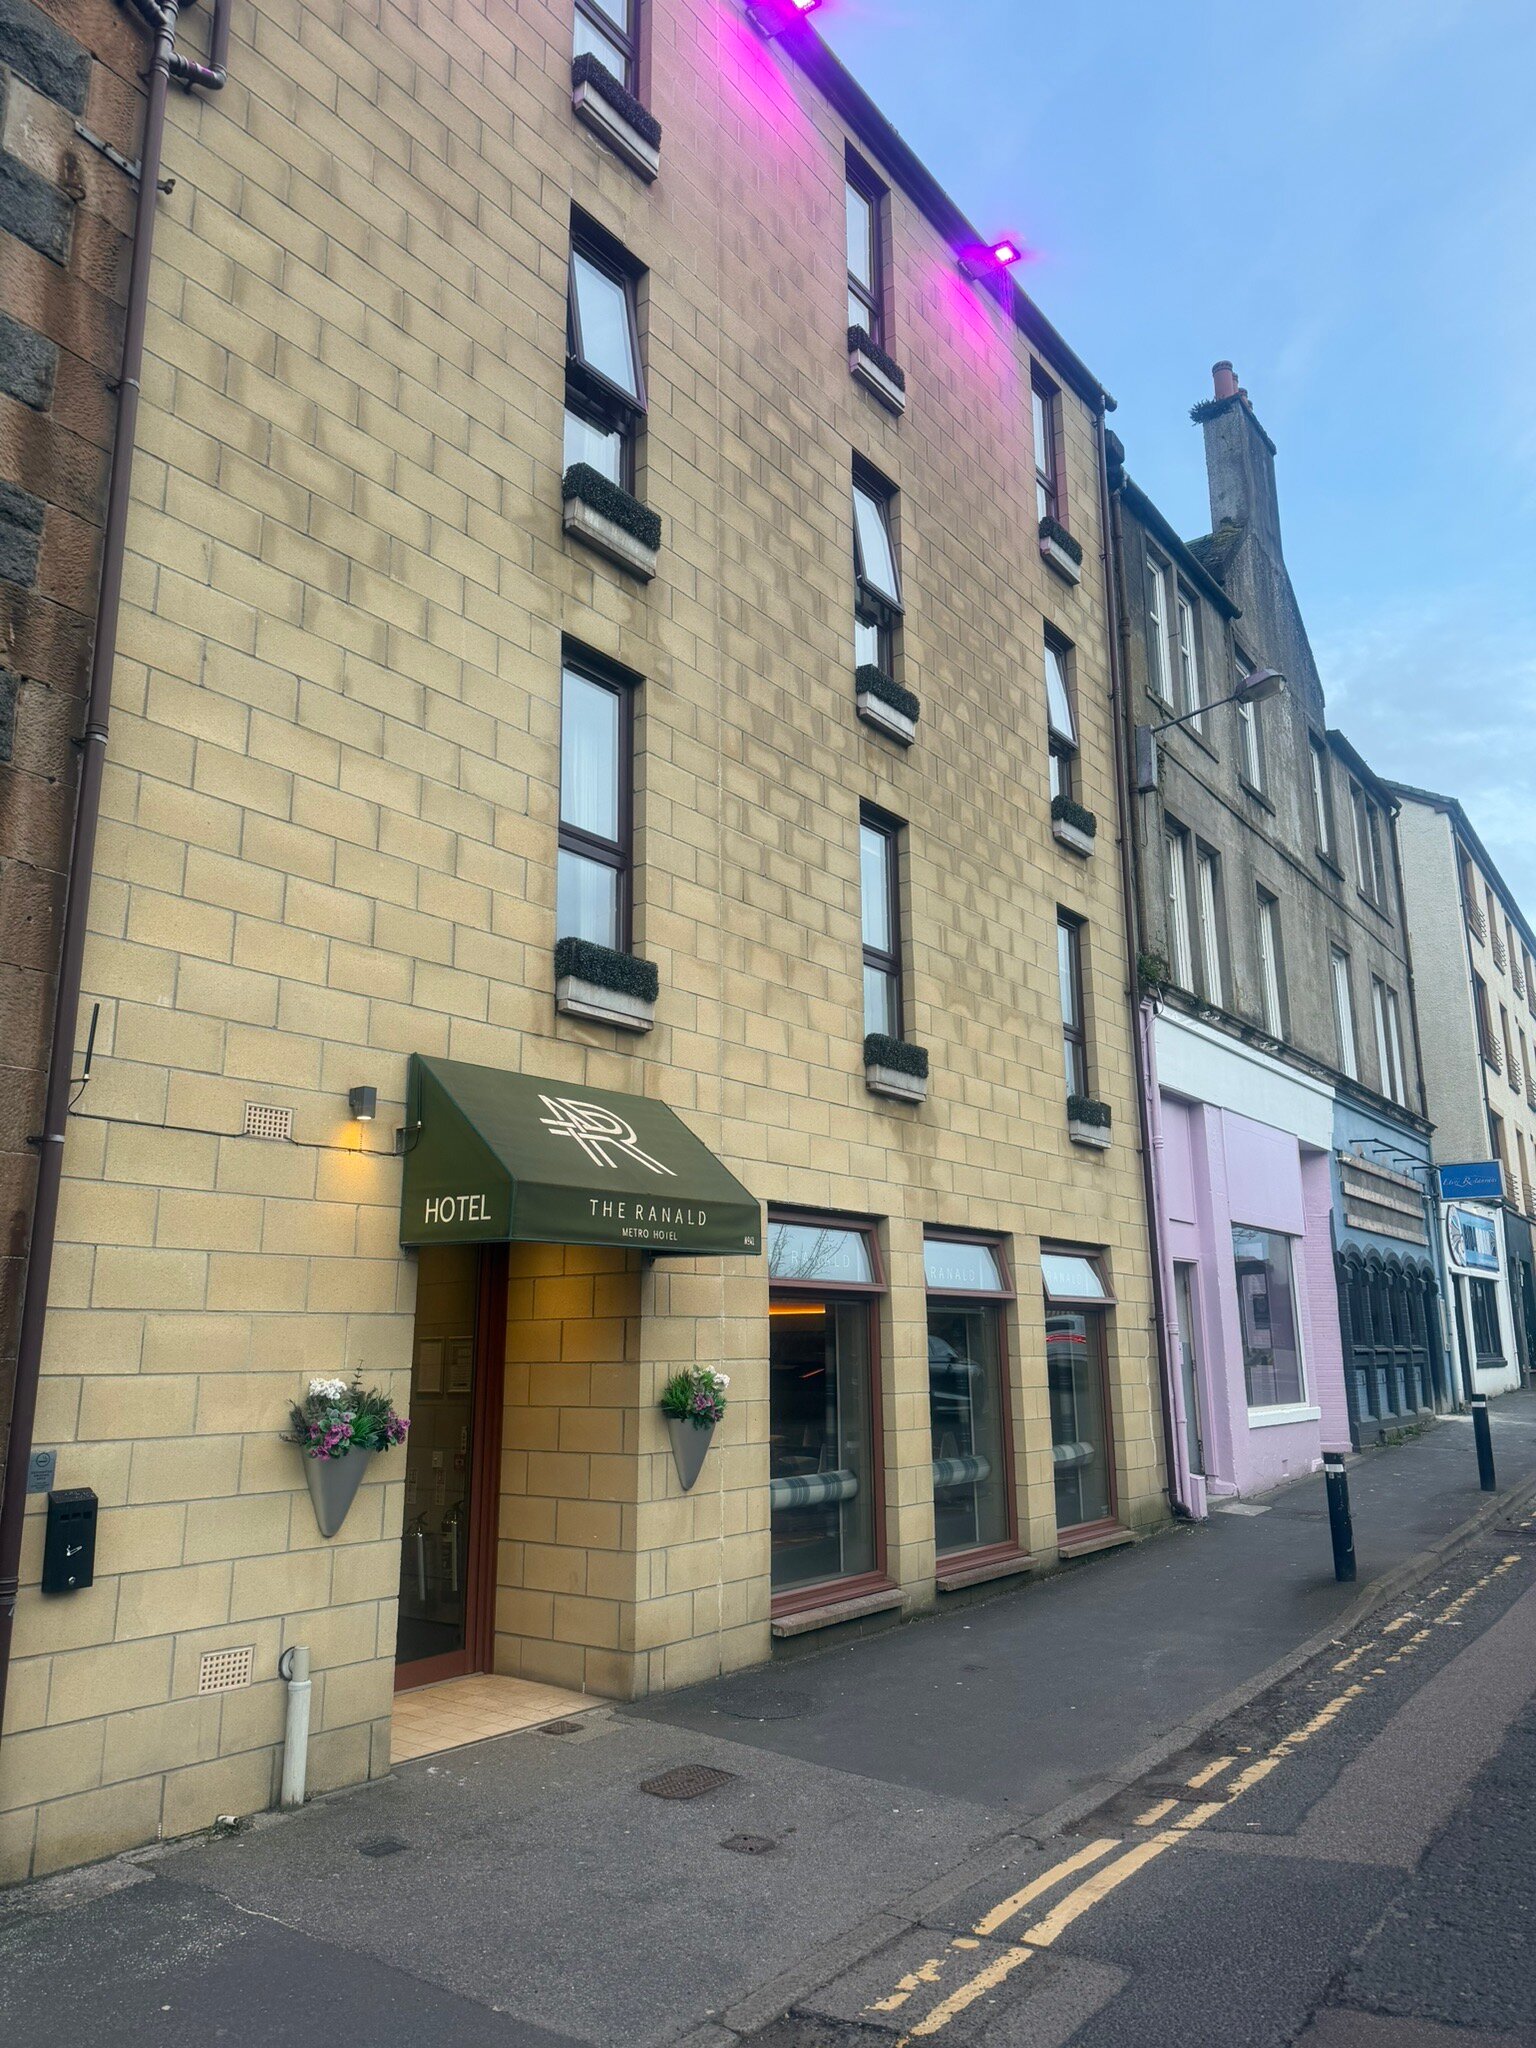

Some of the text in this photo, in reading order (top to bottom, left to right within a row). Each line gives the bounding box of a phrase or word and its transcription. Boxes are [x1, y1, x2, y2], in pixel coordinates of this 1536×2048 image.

[425, 1194, 491, 1224] HOTEL
[590, 1199, 707, 1226] THE RANALD
[622, 1228, 678, 1241] METRO HOTEL
[930, 1267, 976, 1281] RANALD
